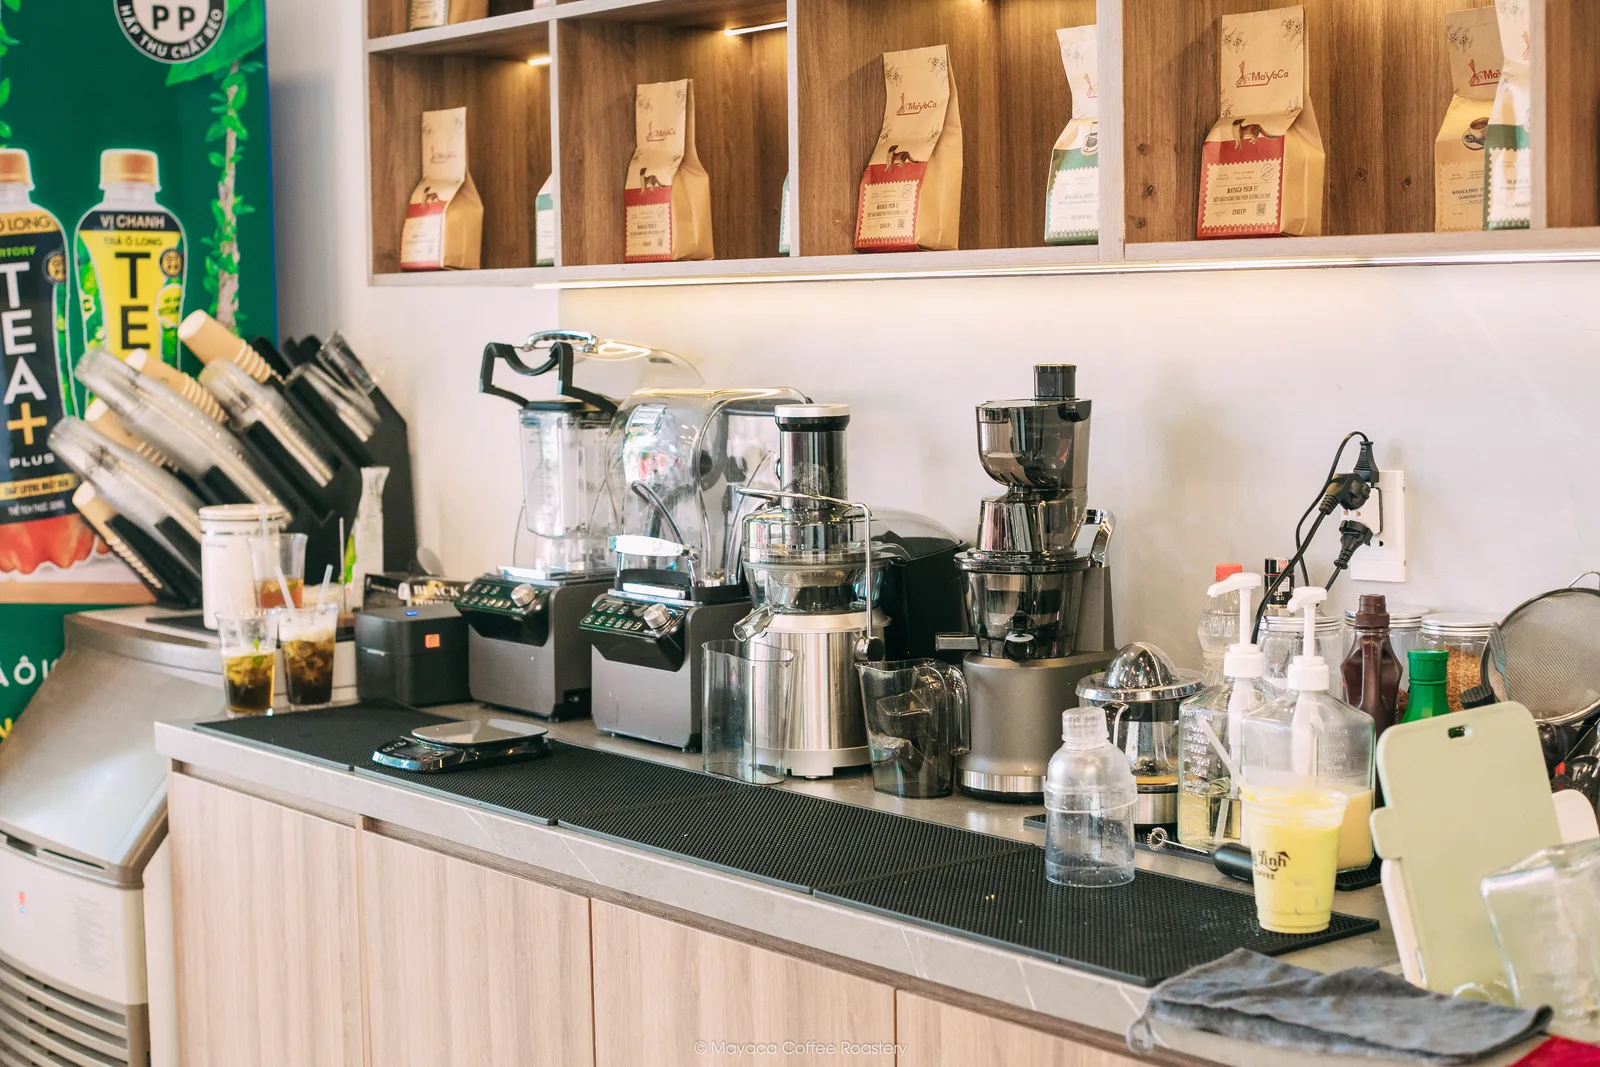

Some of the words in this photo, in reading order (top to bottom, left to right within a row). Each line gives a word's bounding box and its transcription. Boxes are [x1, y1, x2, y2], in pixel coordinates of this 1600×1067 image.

[140, 34, 168, 57] THU
[8, 215, 51, 231] LONG
[100, 214, 114, 230] VỊ
[116, 214, 165, 228] CHANH
[9, 453, 55, 469] PLUS
